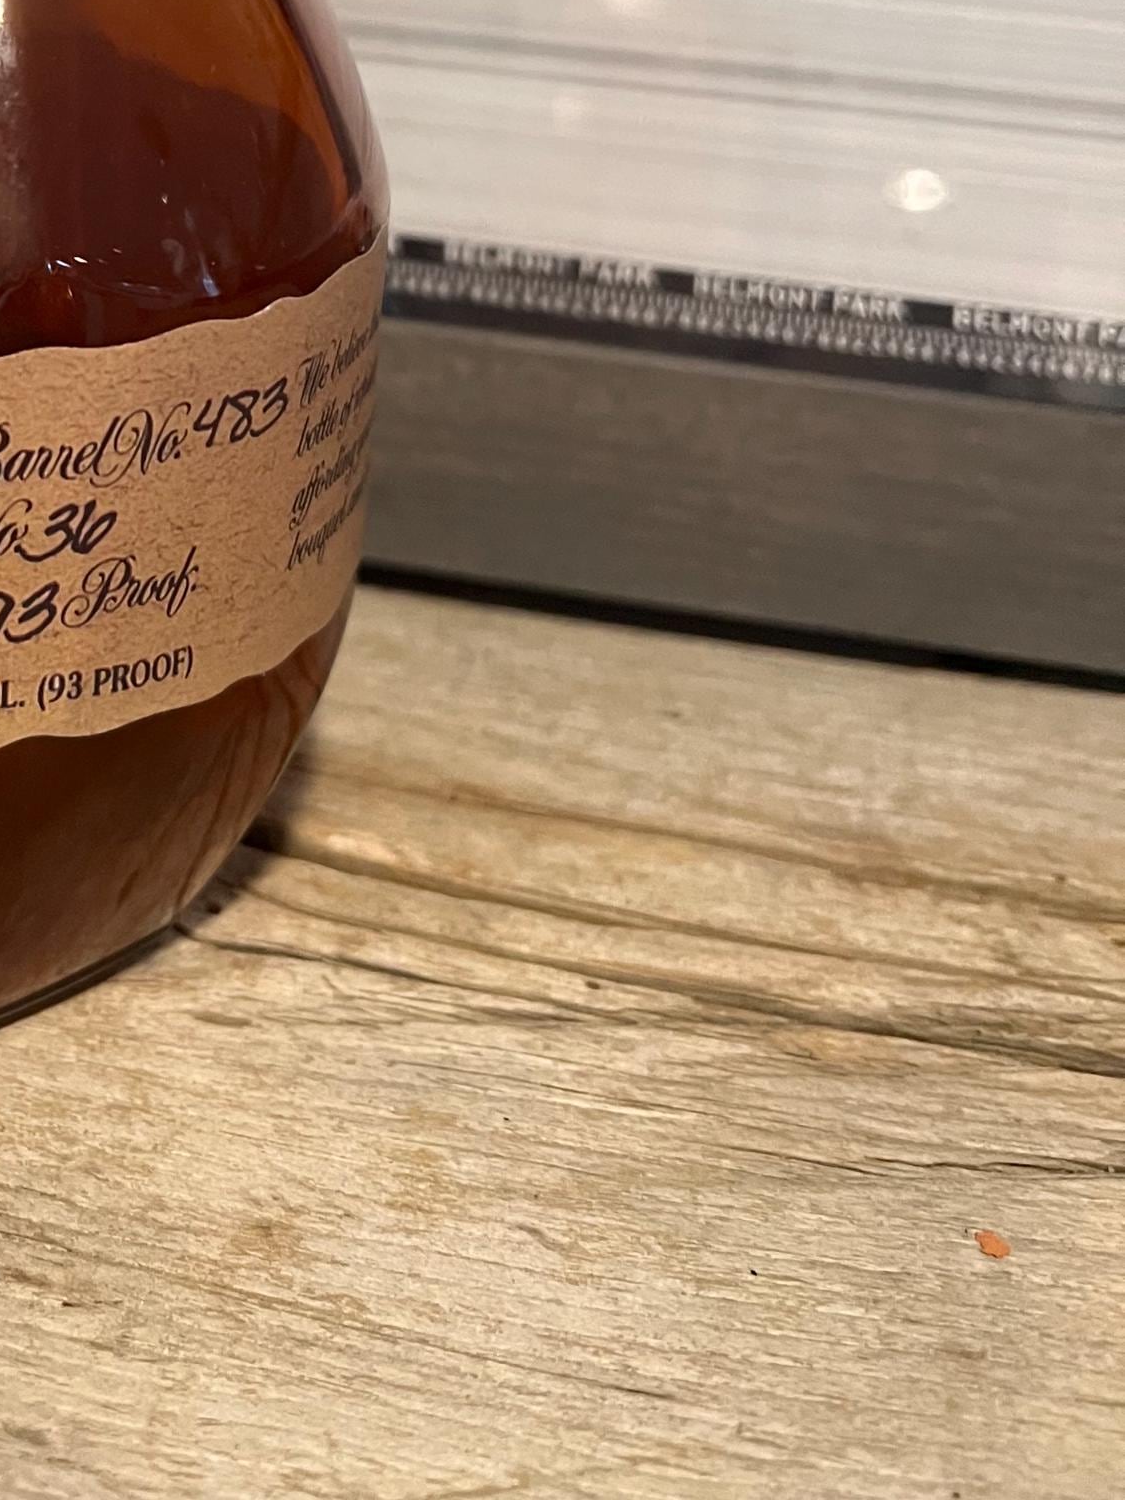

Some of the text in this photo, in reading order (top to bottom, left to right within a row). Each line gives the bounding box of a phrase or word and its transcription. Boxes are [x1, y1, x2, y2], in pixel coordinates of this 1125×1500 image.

[953, 307, 1085, 347] BELMONT
[192, 376, 289, 448] 483
[292, 395, 340, 459] bottle
[17, 499, 119, 563] 36
[36, 673, 84, 712] (93
[91, 644, 195, 699] PROOF)
